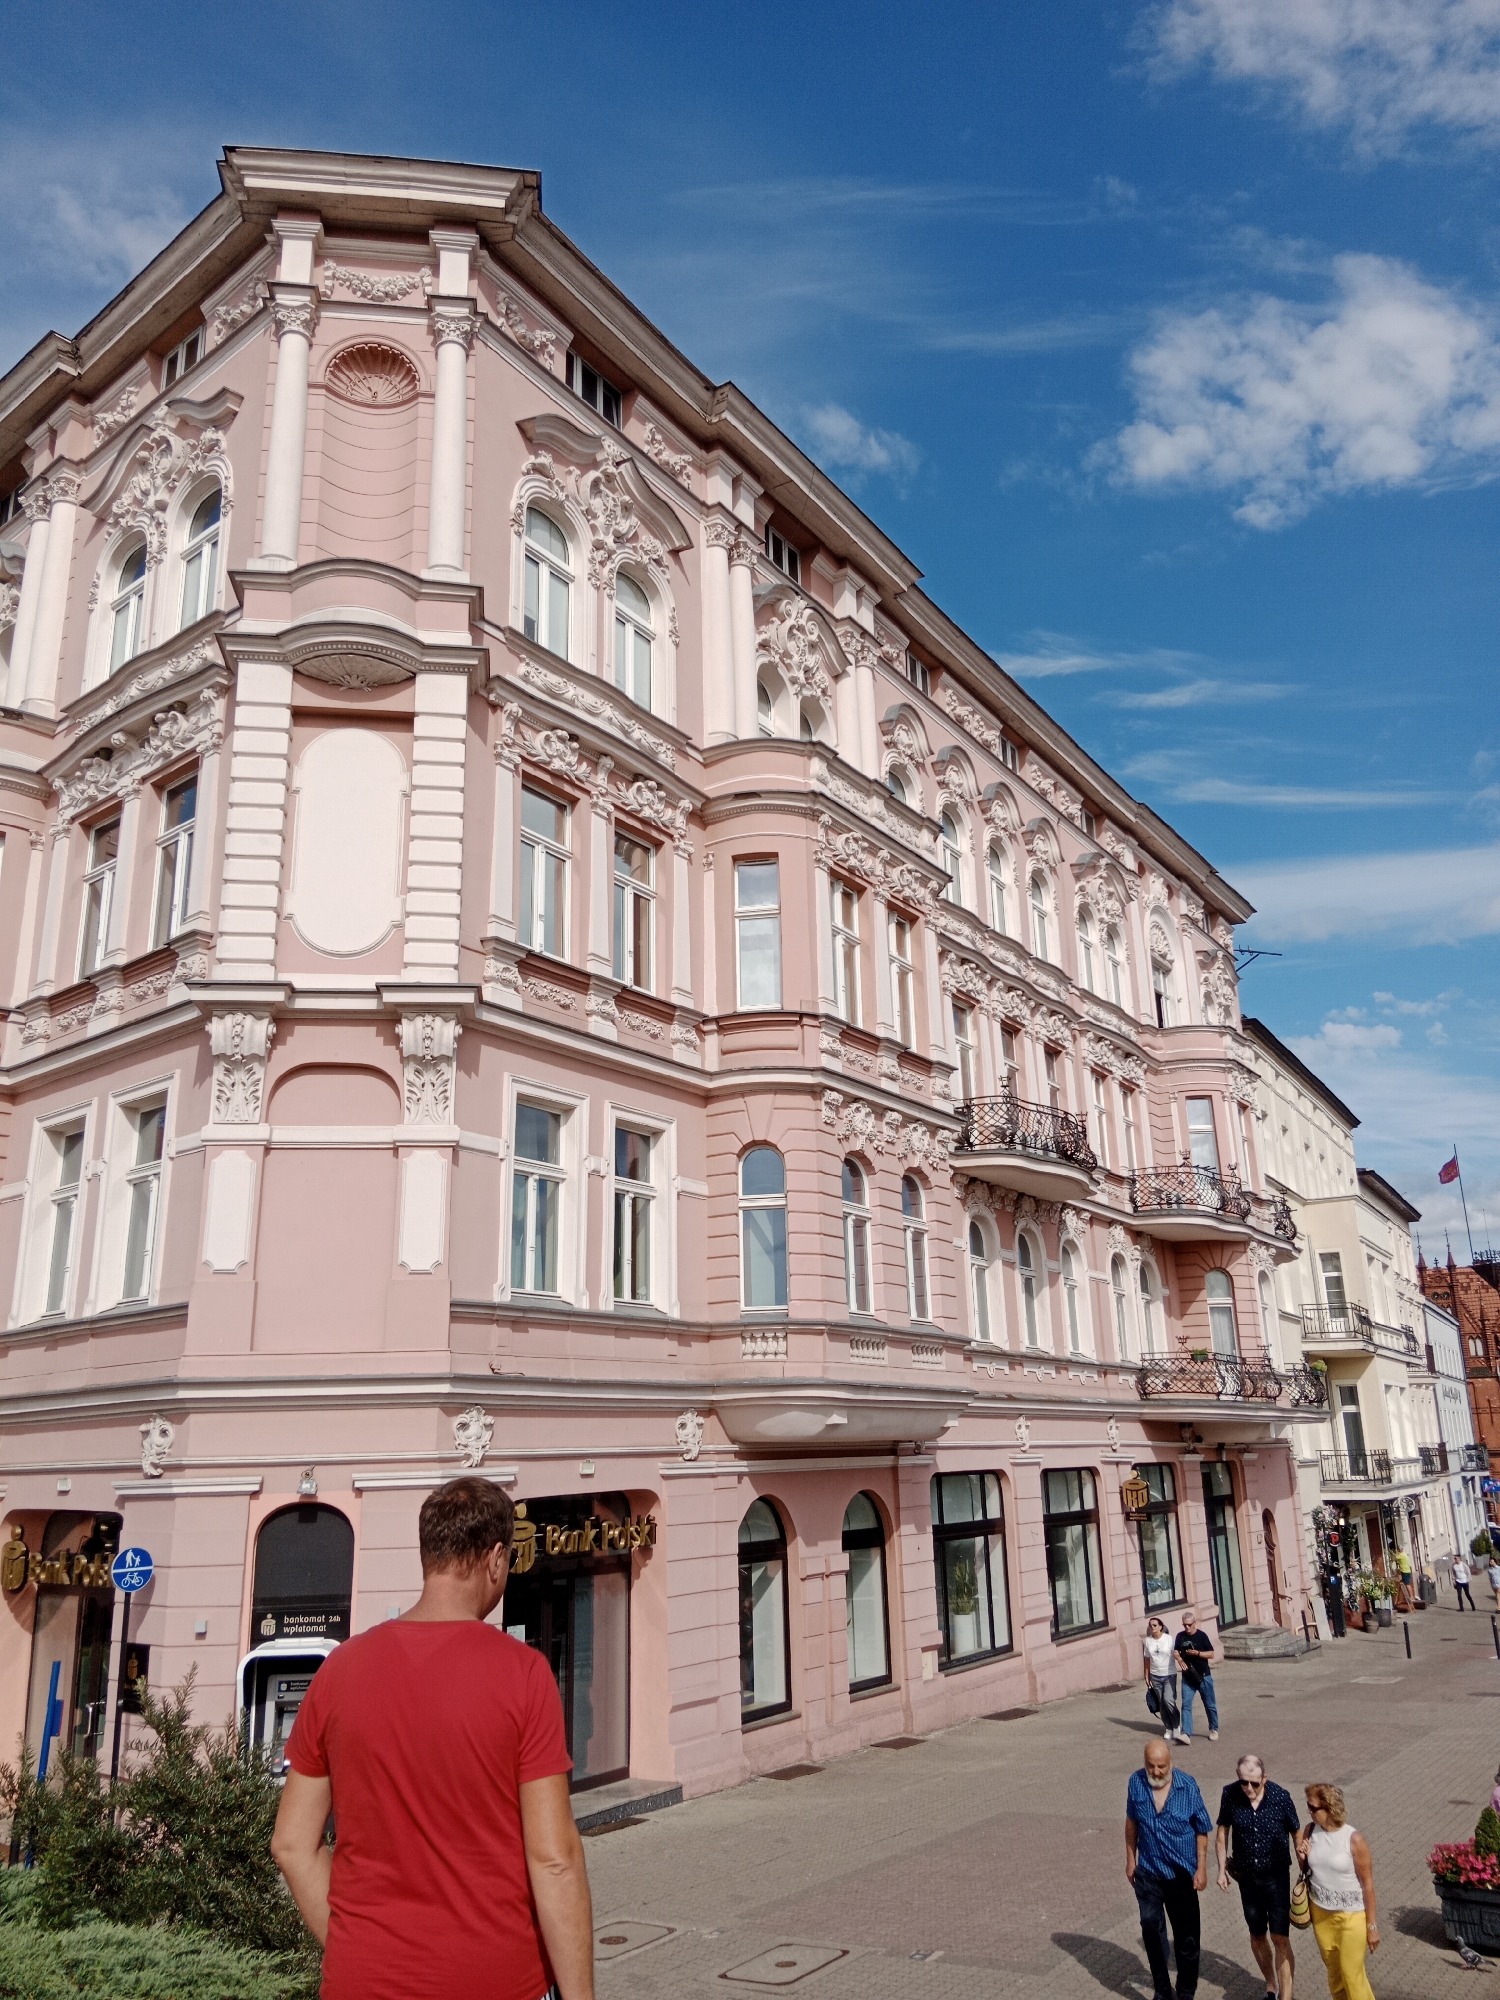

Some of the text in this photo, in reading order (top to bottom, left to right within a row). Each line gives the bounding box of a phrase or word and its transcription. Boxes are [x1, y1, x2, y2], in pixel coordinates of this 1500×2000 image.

[546, 1515, 658, 1556] Bank Polski
[28, 1551, 71, 1585] Bank
[72, 1553, 115, 1588] Pols
[284, 1614, 341, 1624] bankomat 24h
